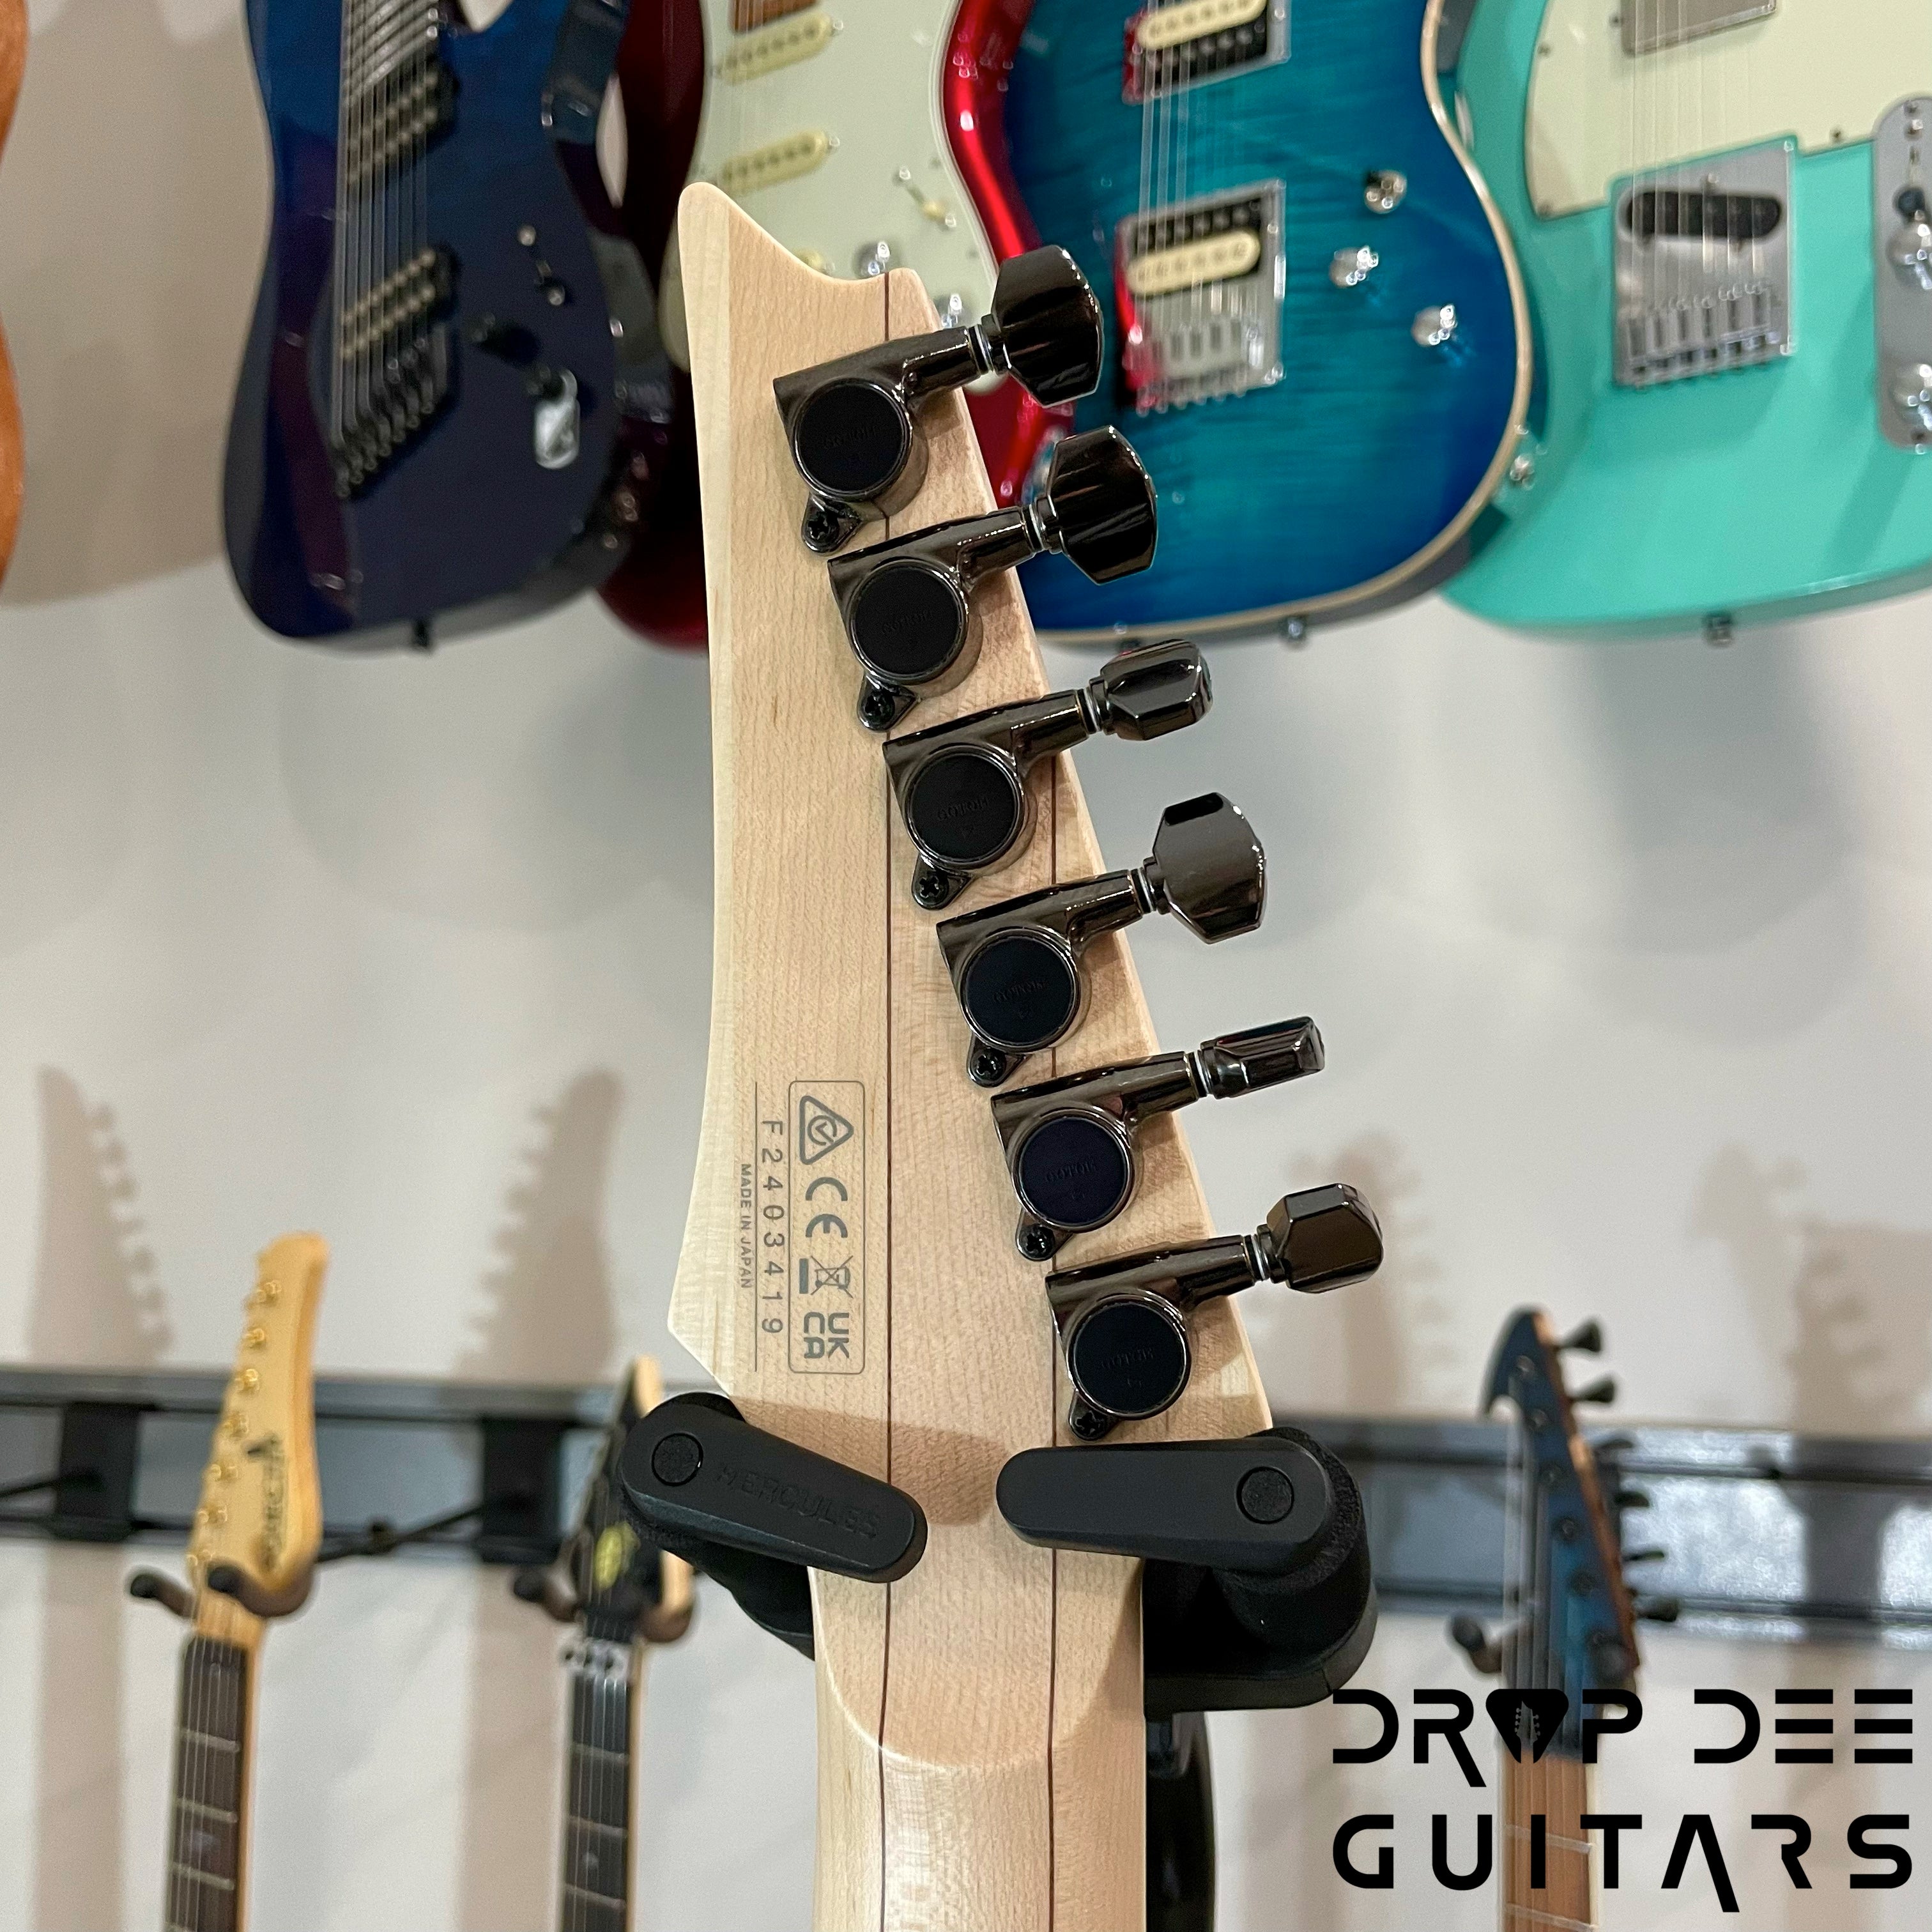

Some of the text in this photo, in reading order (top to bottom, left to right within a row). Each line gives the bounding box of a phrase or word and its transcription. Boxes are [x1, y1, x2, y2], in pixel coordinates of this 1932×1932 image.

[740, 1163, 753, 1289] MADE IN JAPAN
[762, 1119, 785, 1334] F2403419
[804, 1312, 825, 1359] CA
[828, 1312, 850, 1359] UK
[716, 1464, 880, 1539] HERCULES
